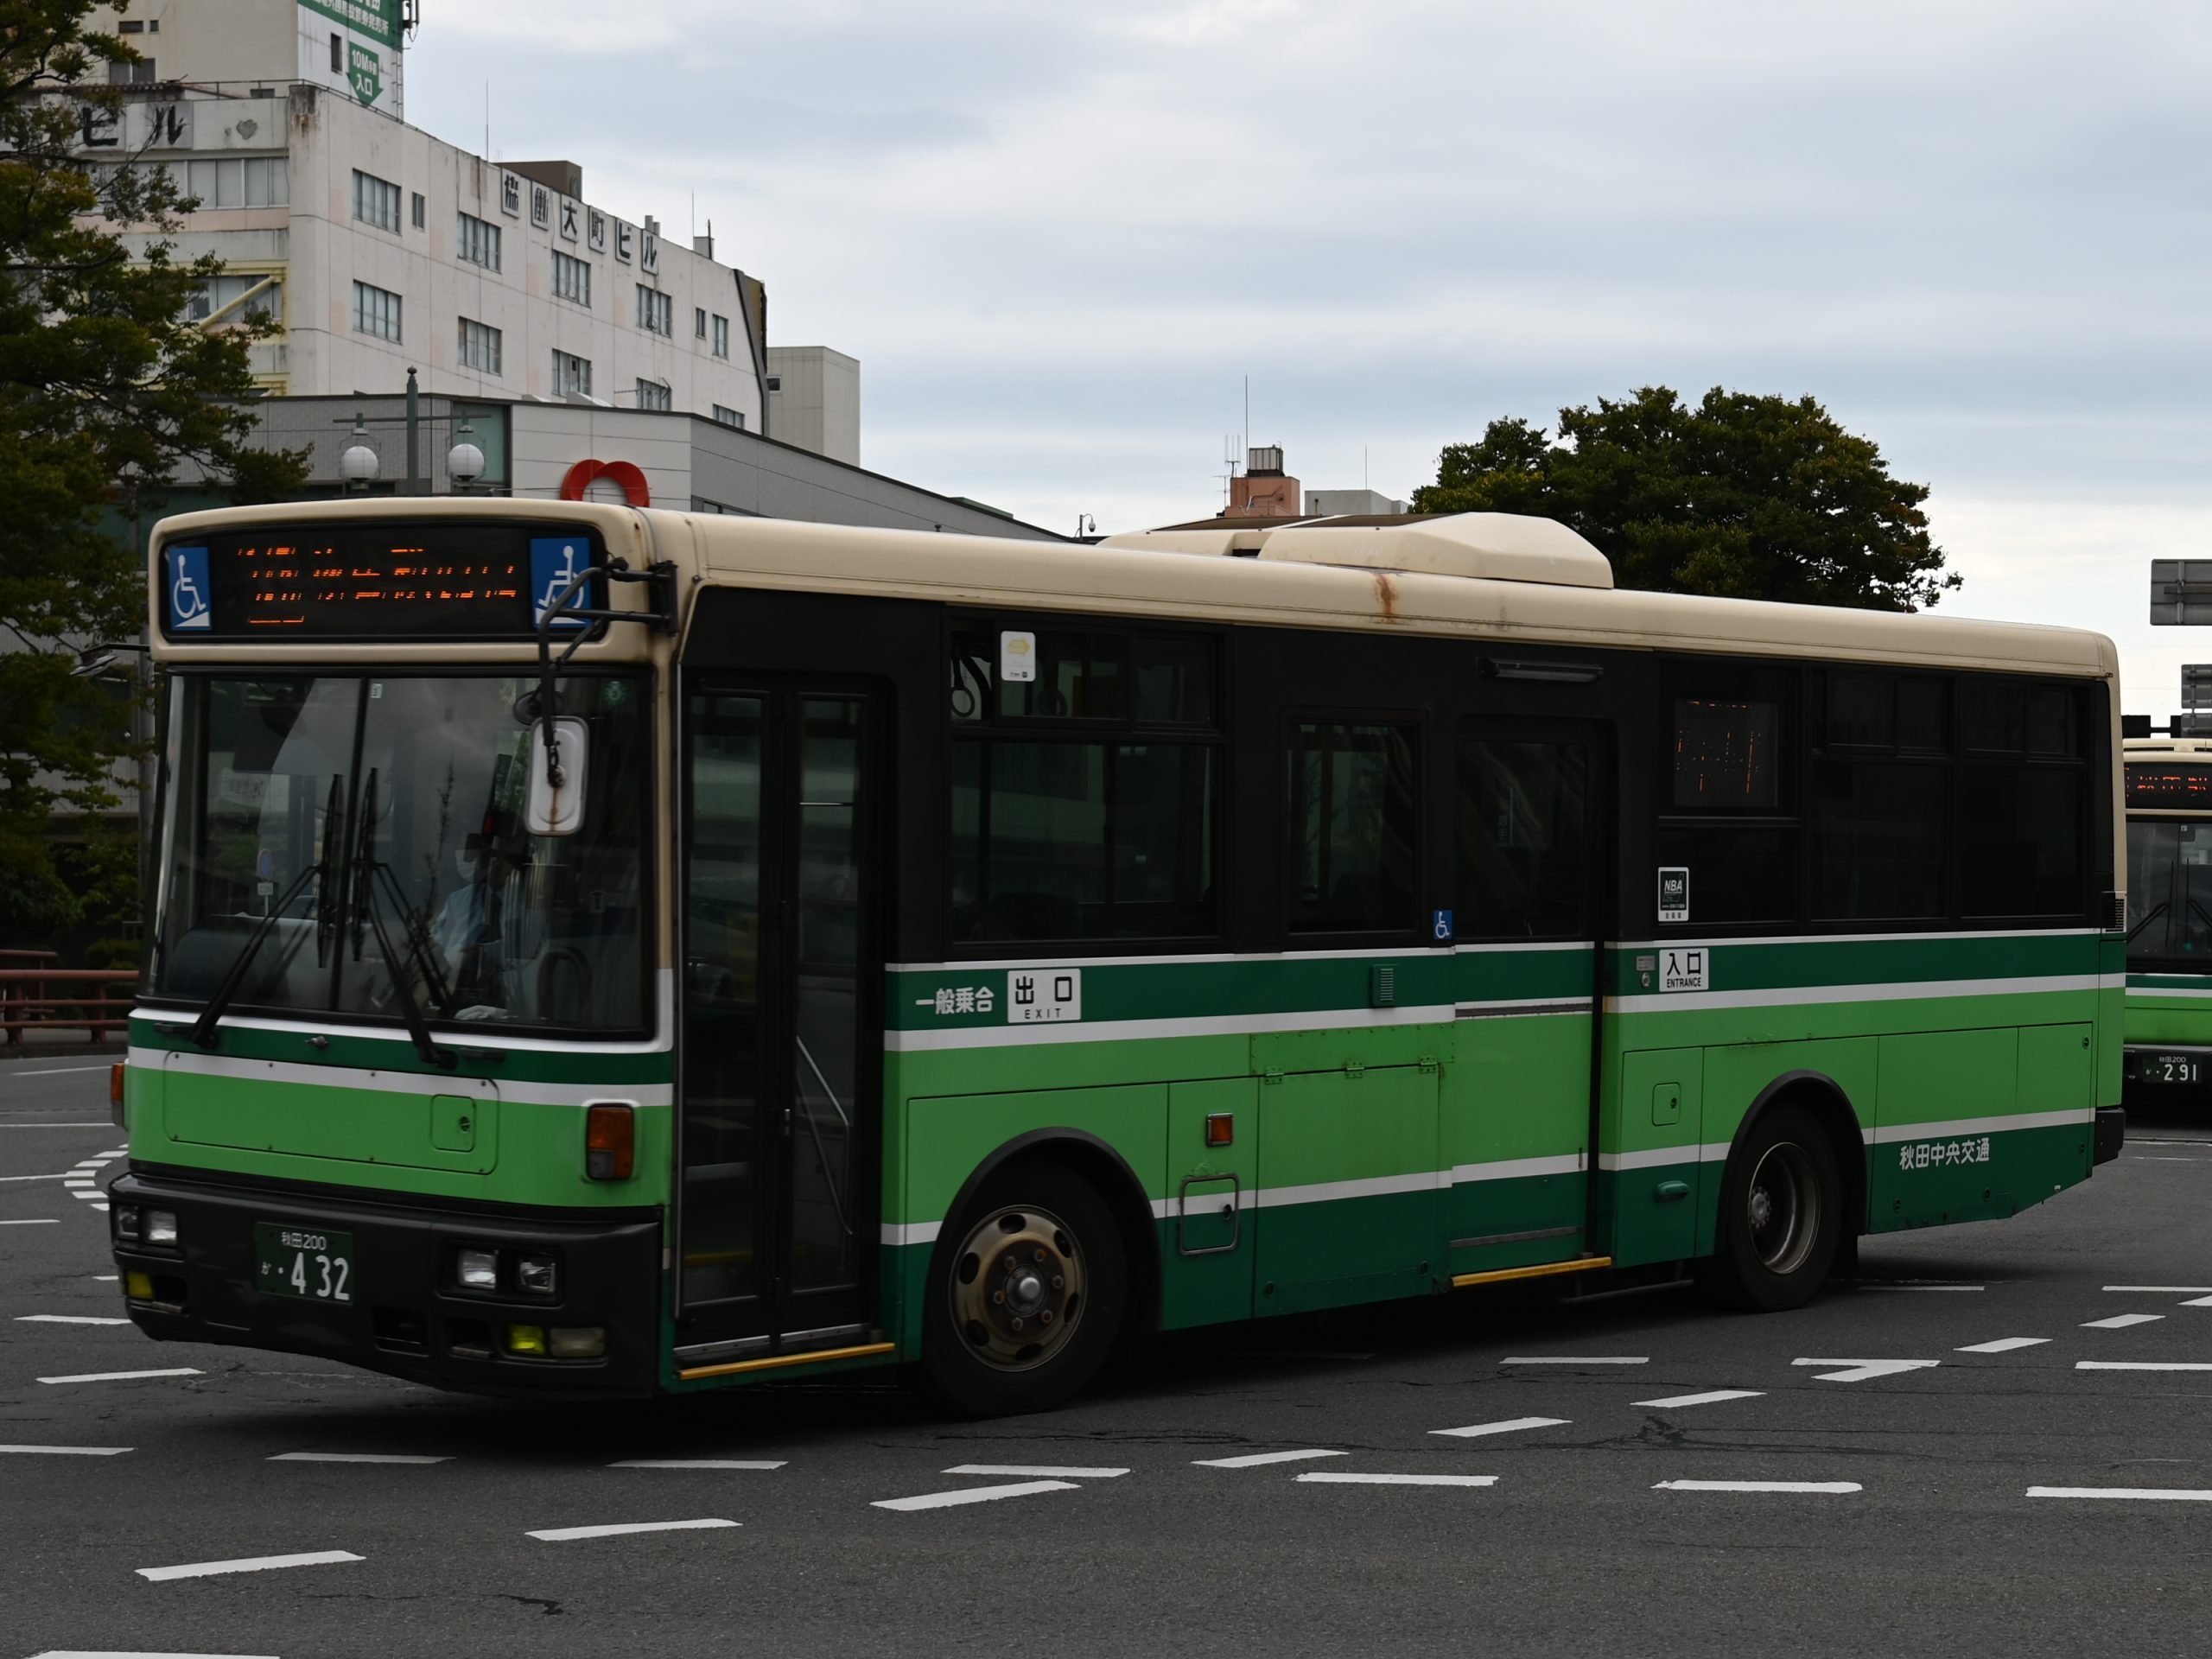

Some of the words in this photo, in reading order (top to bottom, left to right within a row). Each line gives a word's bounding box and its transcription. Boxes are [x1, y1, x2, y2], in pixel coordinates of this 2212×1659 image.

[356, 73, 373, 97] 入口
[1664, 880, 1683, 892] NBA
[1667, 952, 1701, 976] 入口
[1014, 976, 1072, 1005] 出口
[1666, 976, 1701, 988] ENTRANCE
[916, 986, 995, 1015] 一般乗合
[1024, 1007, 1062, 1020] EXIT
[1899, 1137, 1991, 1172] 秋田中央交通
